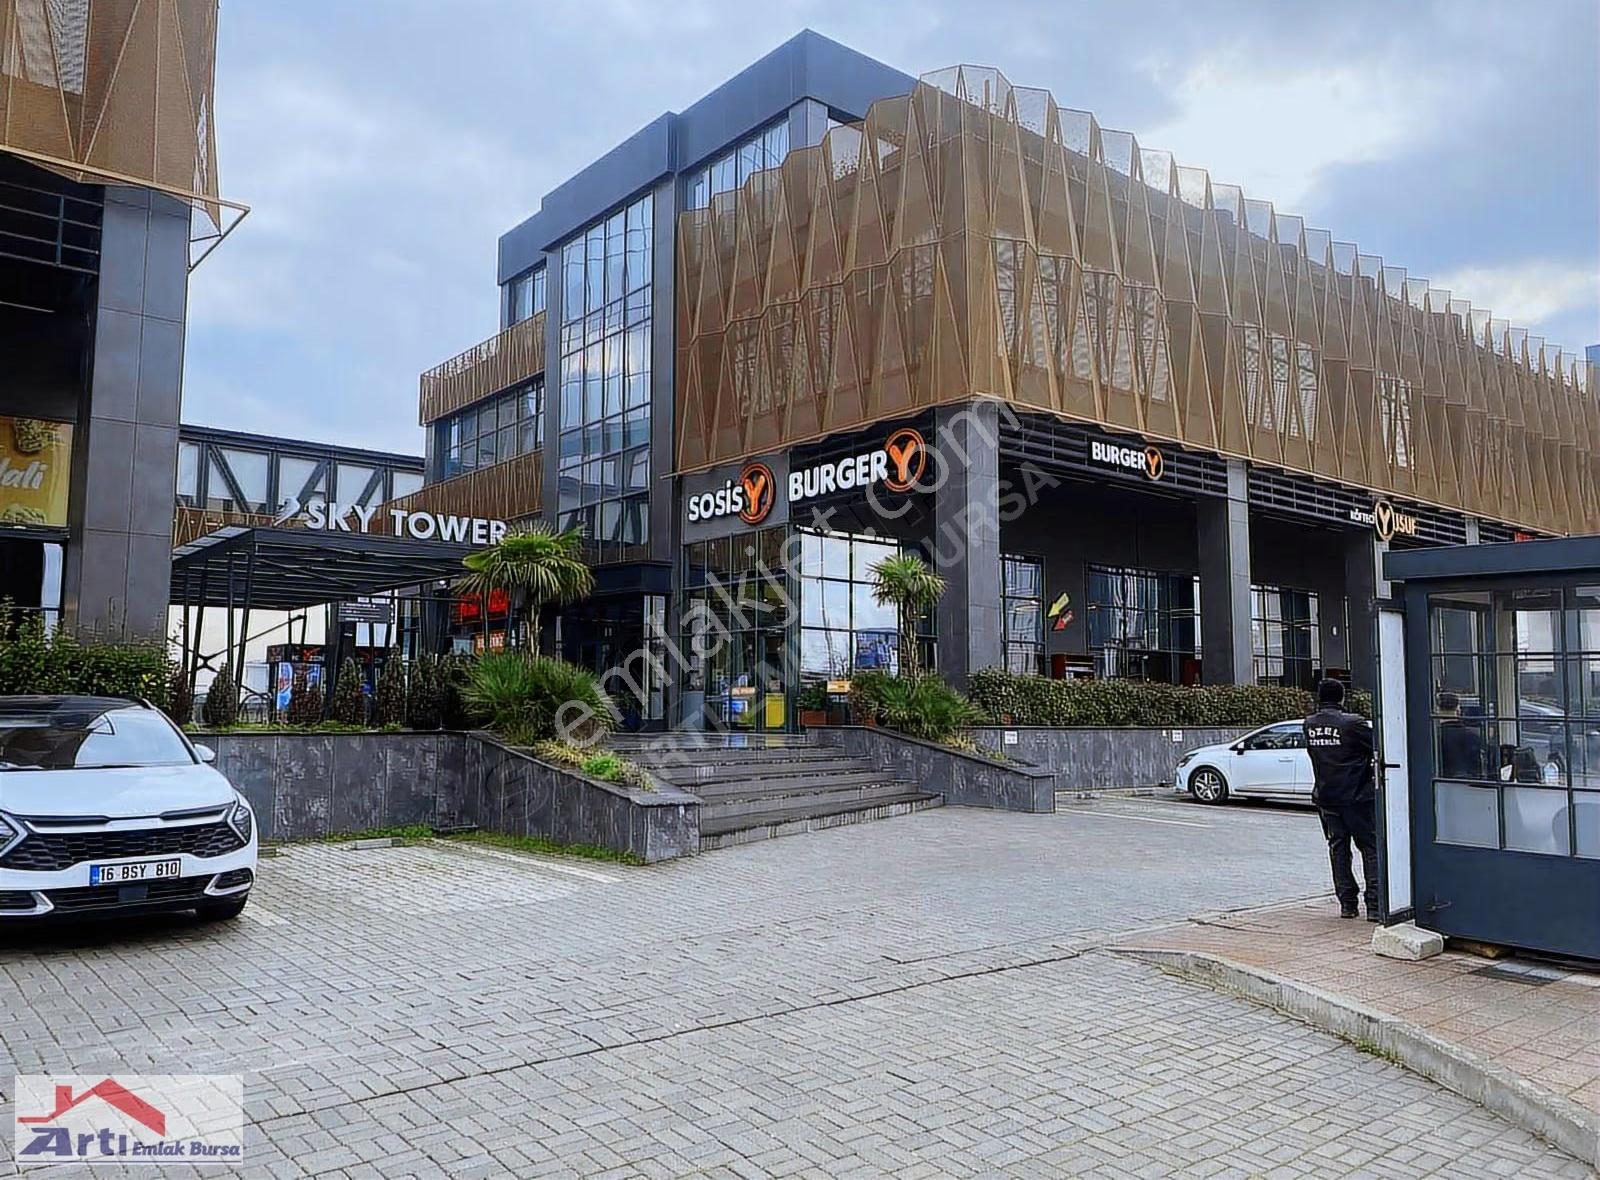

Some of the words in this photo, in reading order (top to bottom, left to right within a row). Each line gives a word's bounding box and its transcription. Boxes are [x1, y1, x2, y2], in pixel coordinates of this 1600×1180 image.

[1091, 441, 1147, 470] BURGER
[788, 450, 888, 502] BURGER
[305, 502, 378, 533] SKY
[390, 509, 508, 546] TOWER
[101, 867, 114, 881] 16
[121, 864, 147, 880] BSY
[155, 862, 178, 877] 810
